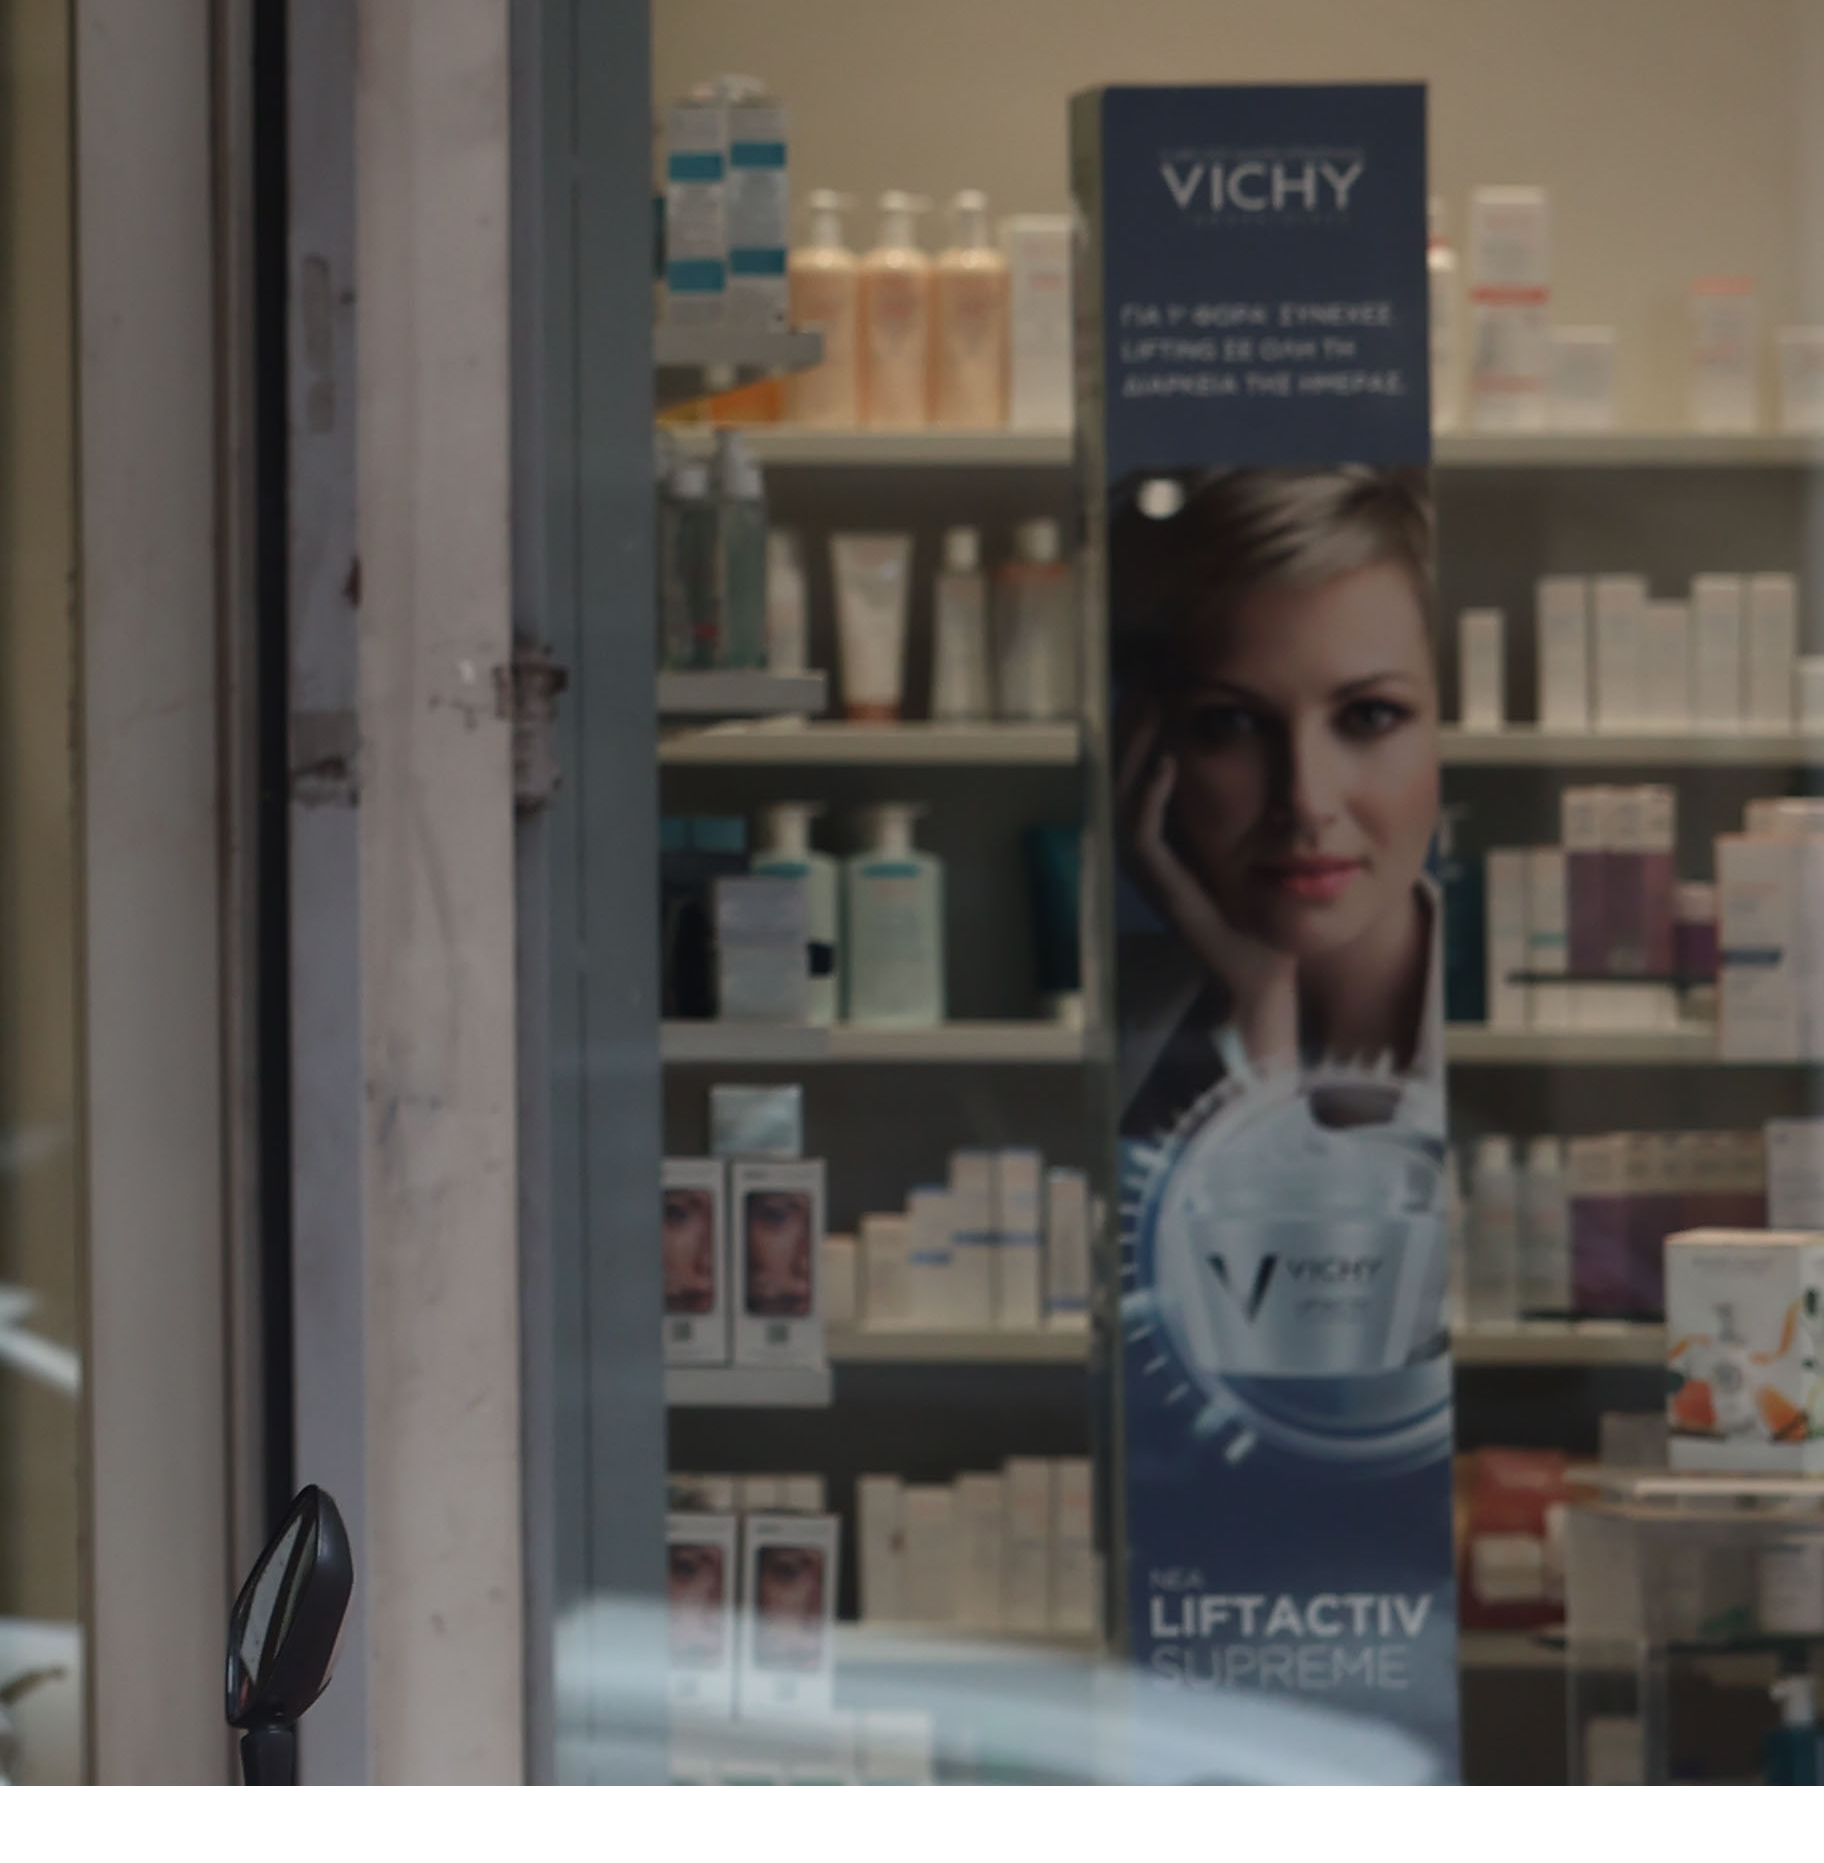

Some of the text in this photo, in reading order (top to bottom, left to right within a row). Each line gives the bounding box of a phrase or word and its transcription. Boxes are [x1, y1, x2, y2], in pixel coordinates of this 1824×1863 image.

[1159, 160, 1364, 211] VICHY
[1150, 1594, 1433, 1639] LIFTACTIV
[1151, 1643, 1410, 1689] SUPREME
